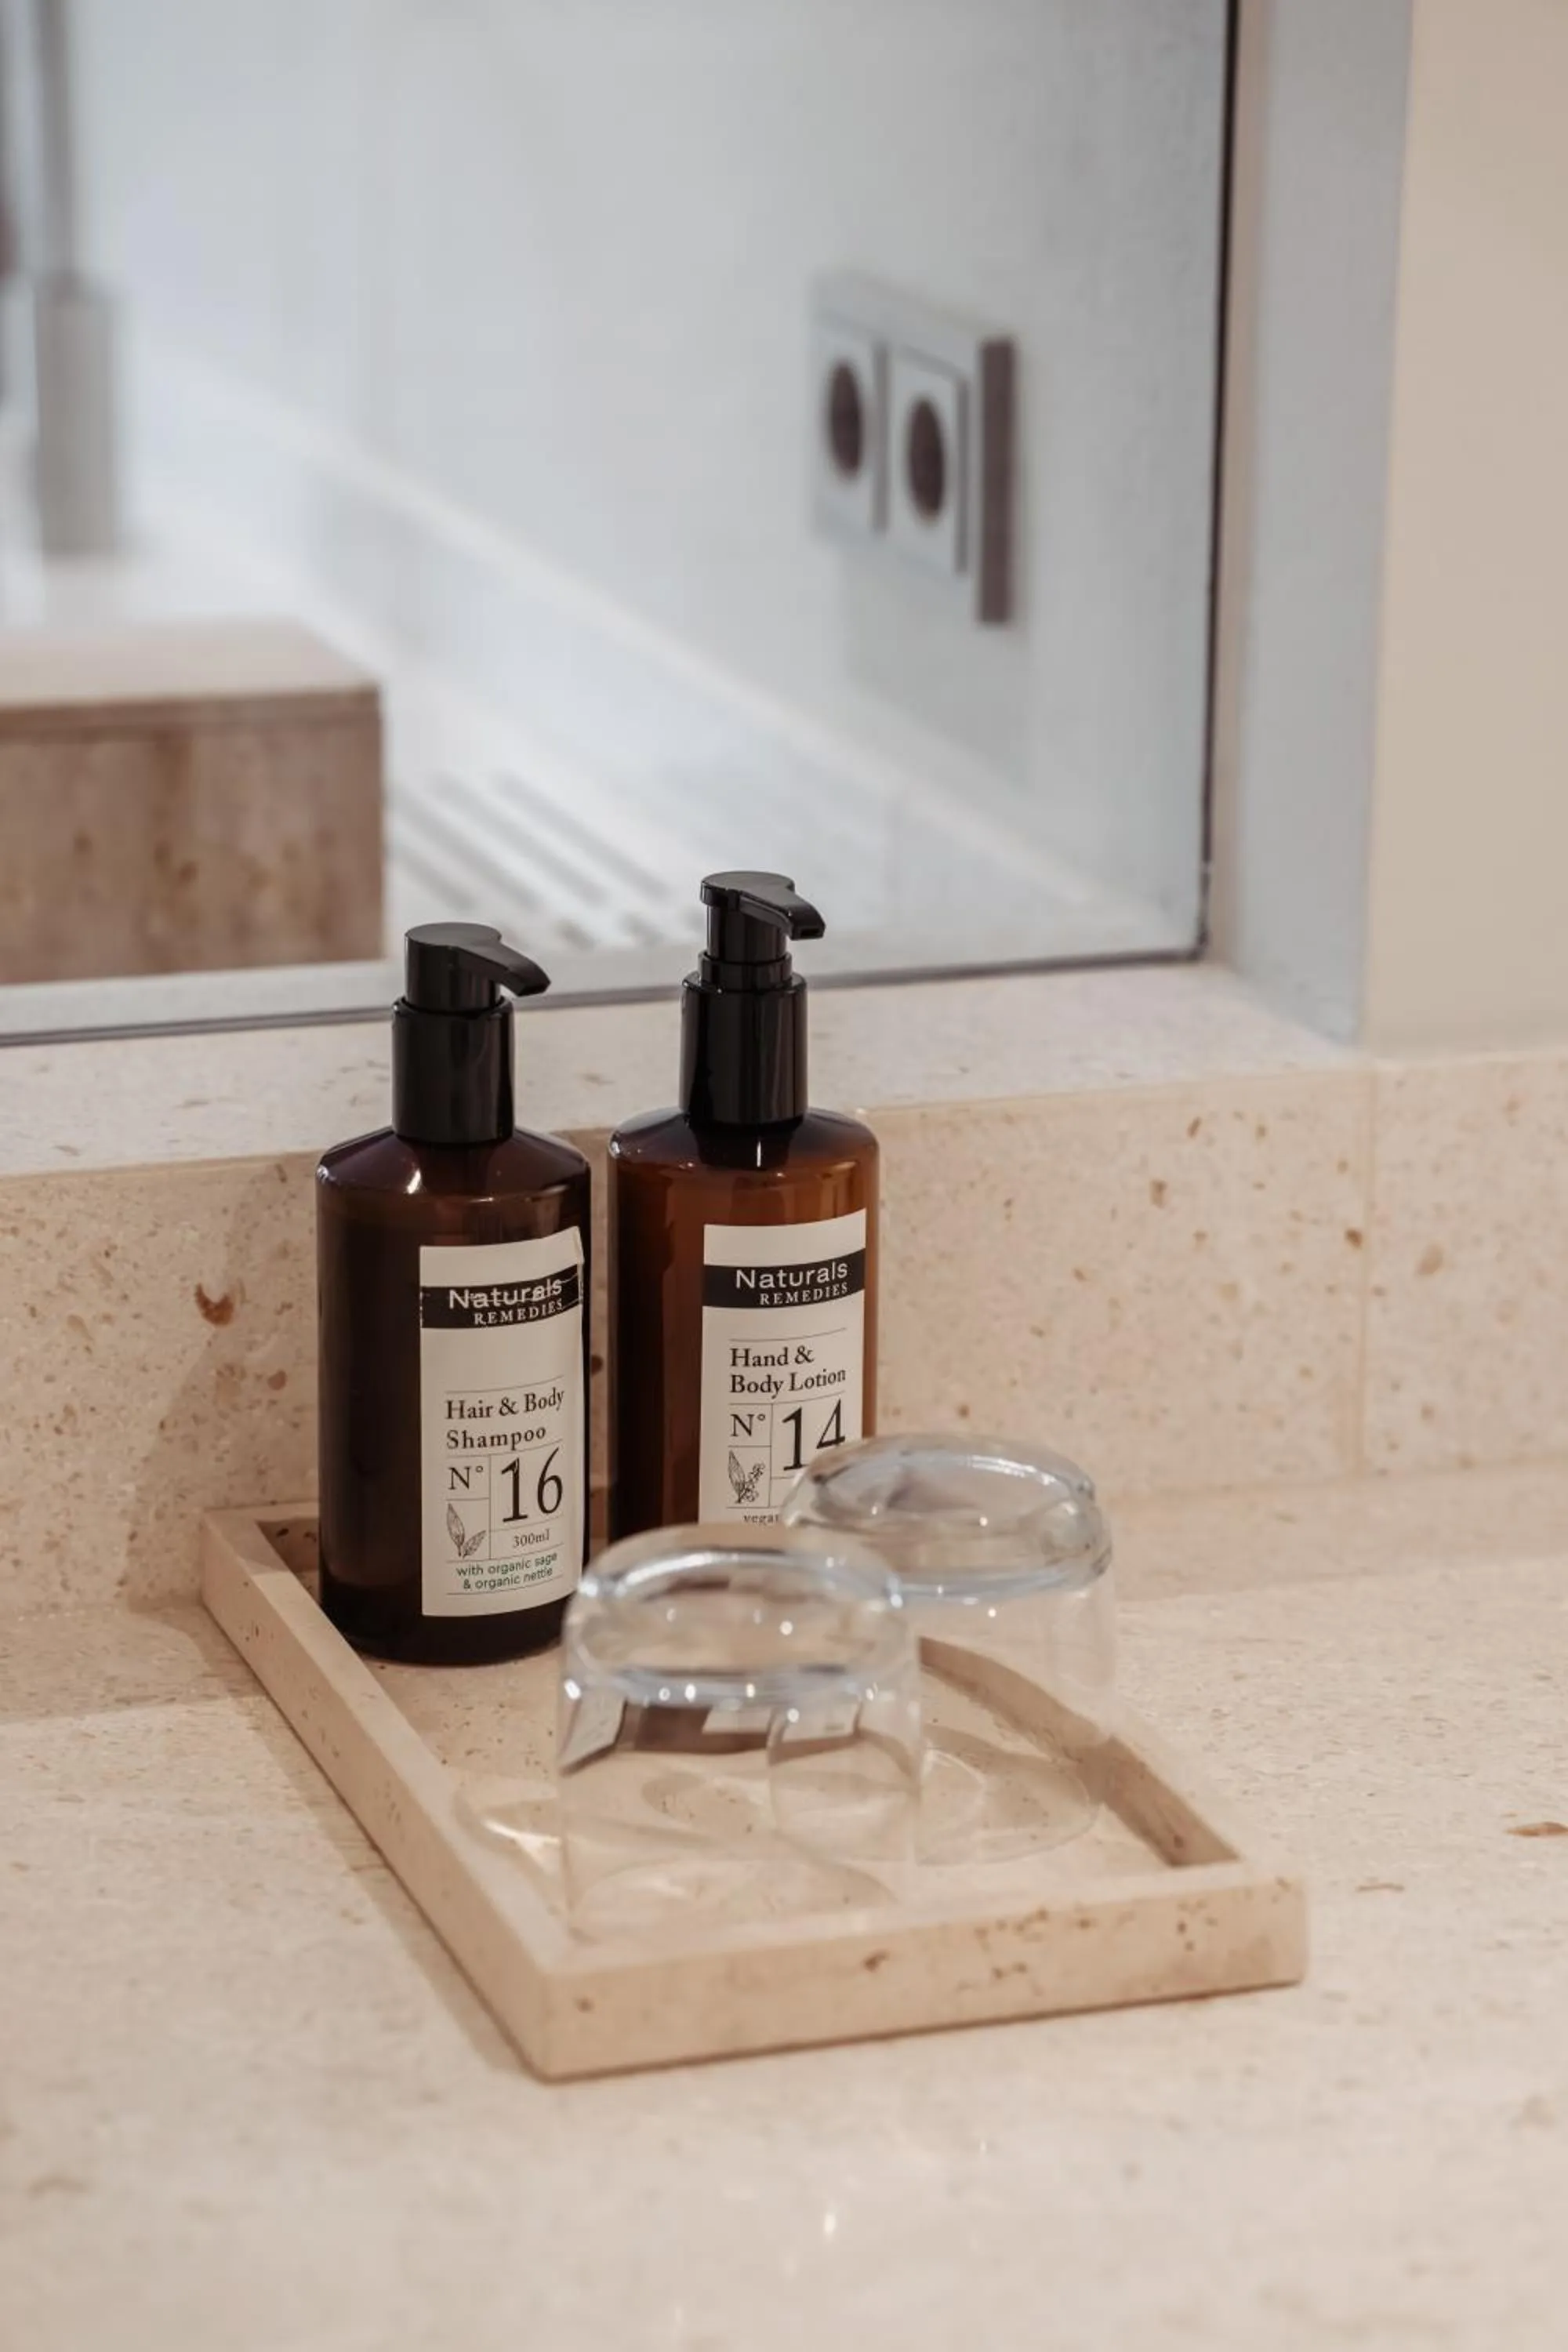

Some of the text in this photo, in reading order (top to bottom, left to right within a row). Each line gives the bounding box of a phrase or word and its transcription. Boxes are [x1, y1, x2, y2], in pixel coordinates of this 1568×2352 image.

[735, 1261, 848, 1290] Naturals
[448, 1279, 563, 1309] Naturals
[760, 1282, 848, 1305] REMEDIES
[474, 1298, 563, 1326] REMEDIES
[730, 1345, 815, 1367] Hand &
[730, 1368, 847, 1399] Body Lotion
[445, 1386, 564, 1420] Hair & Body
[446, 1427, 546, 1450] Shampoo
[782, 1398, 846, 1471] 14
[501, 1446, 563, 1523] 16
[513, 1529, 551, 1548] 300ml
[456, 1552, 557, 1577] with organic sage
[463, 1566, 554, 1590] & organic nettle
